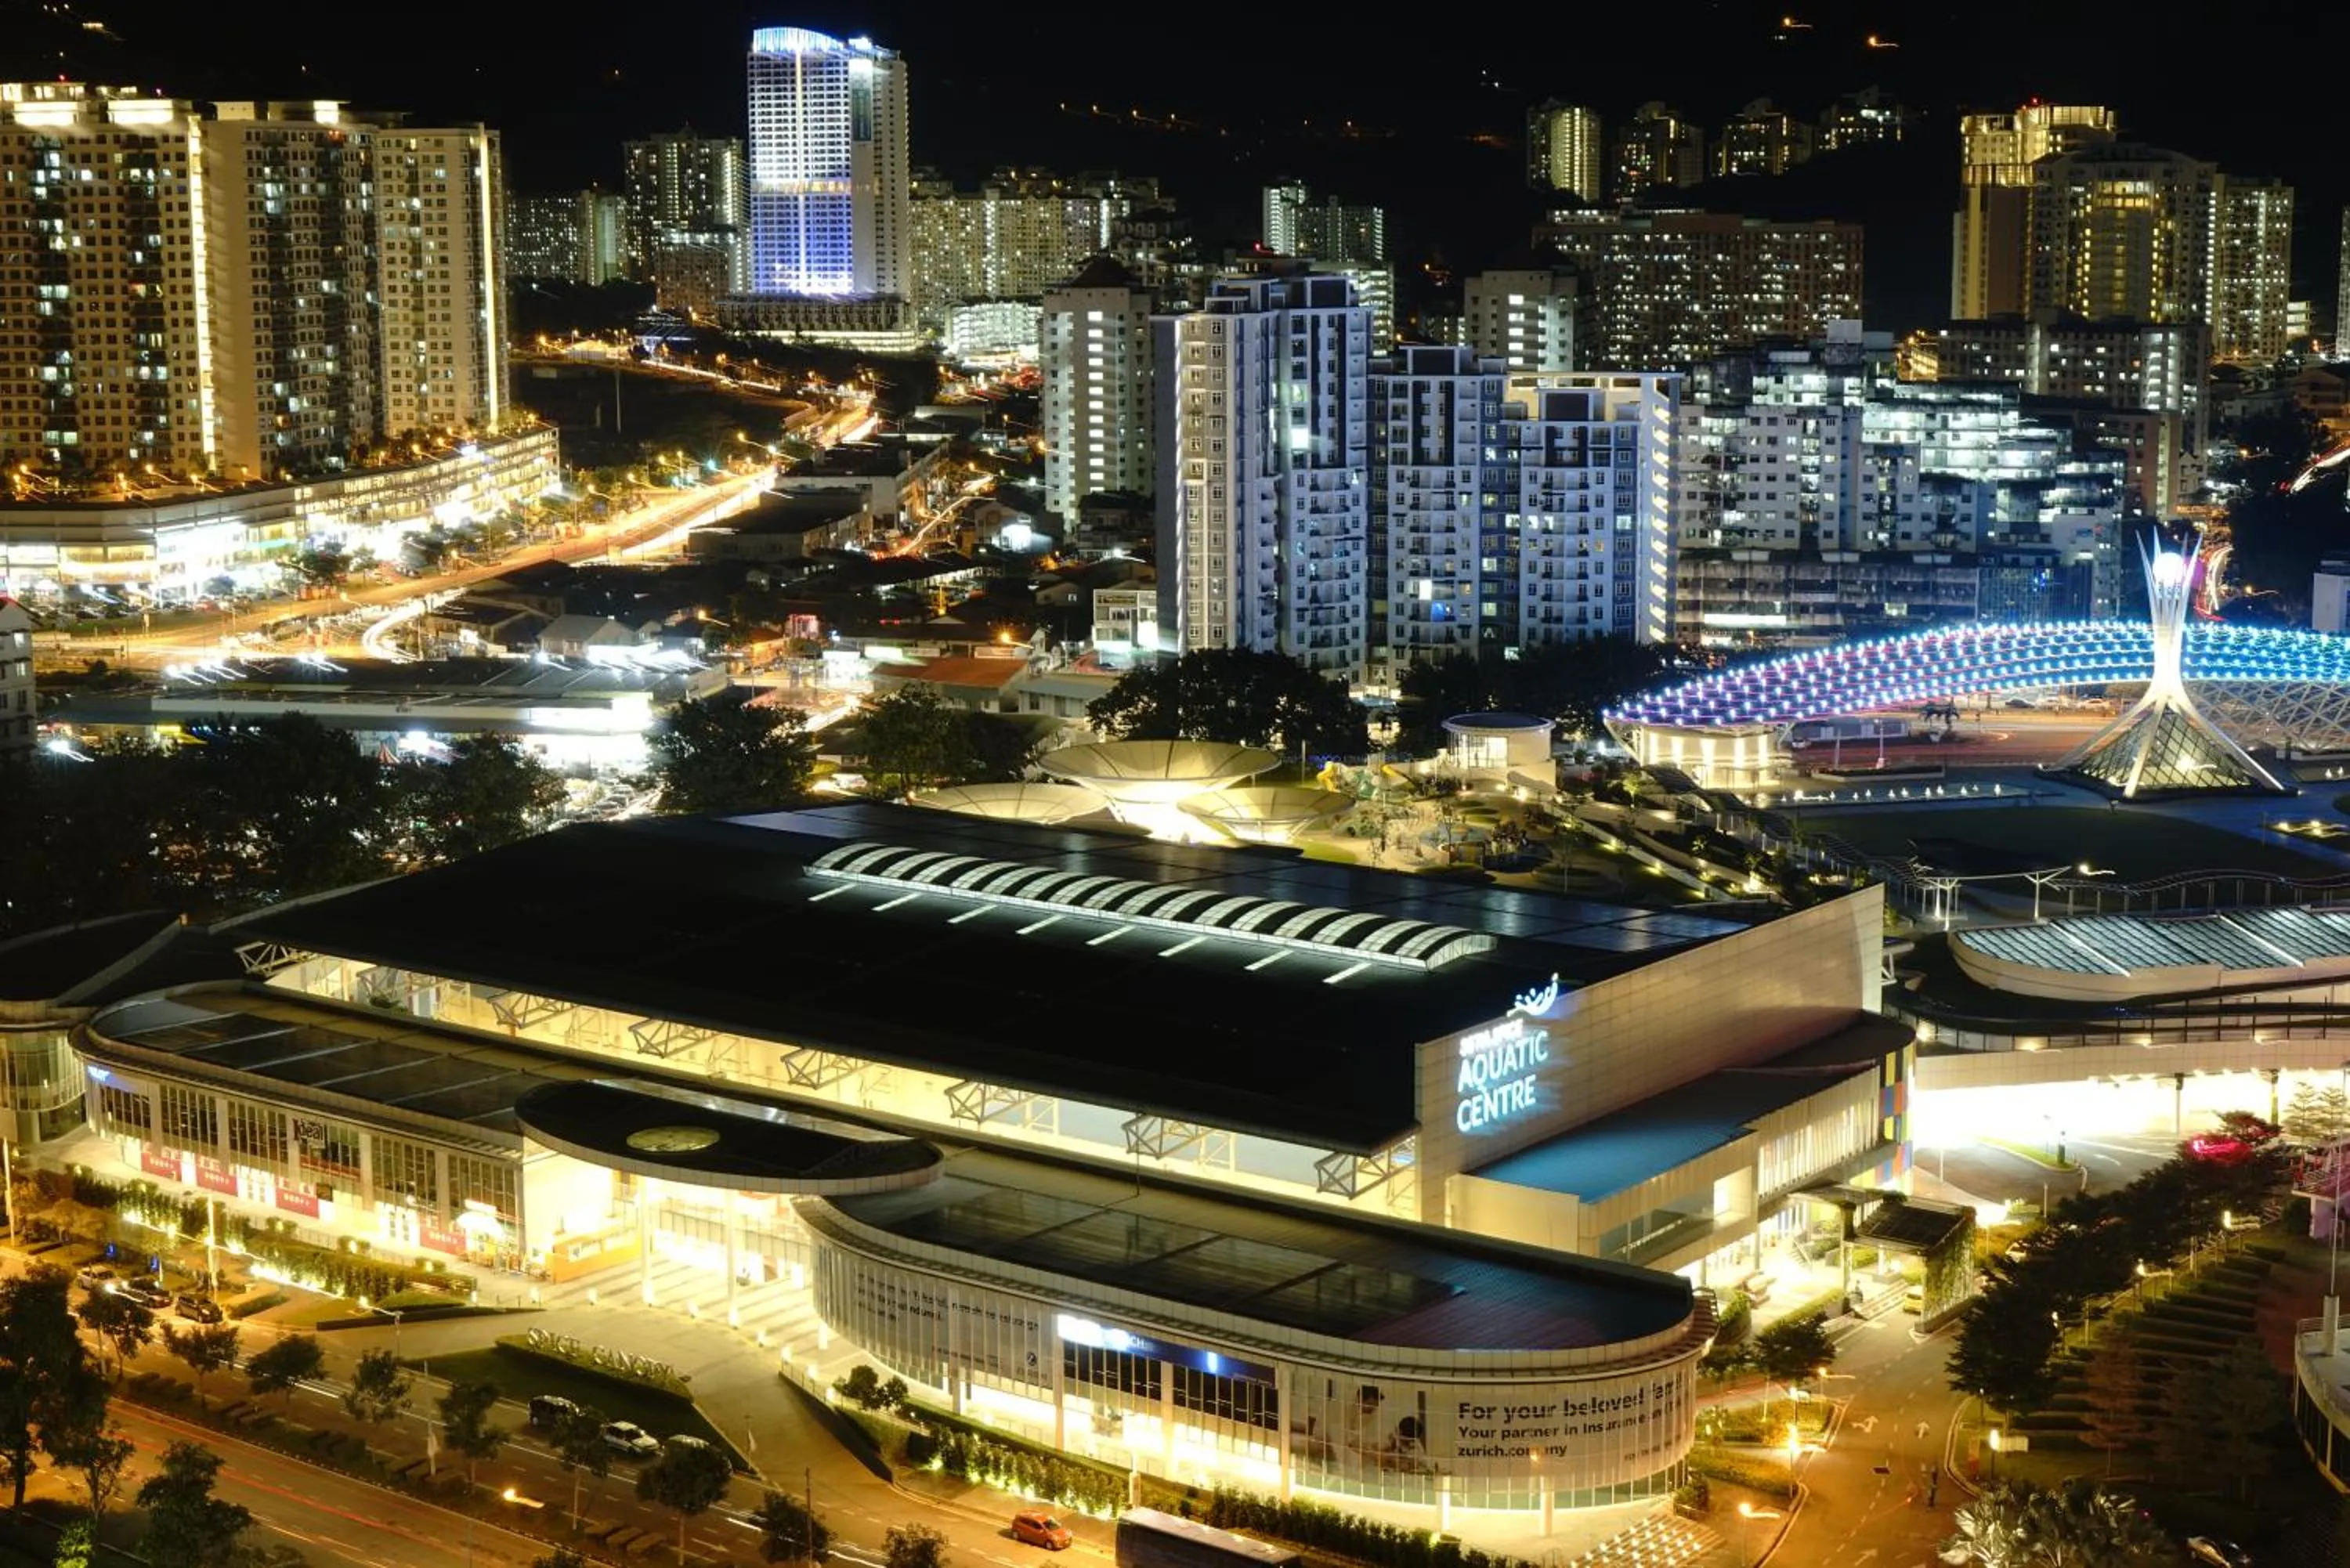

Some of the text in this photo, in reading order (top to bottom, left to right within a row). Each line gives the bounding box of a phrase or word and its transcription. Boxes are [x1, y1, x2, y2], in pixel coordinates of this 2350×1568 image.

[1458, 1031, 1548, 1093] AQUATIC
[1457, 1075, 1536, 1132] CENTRE
[1459, 1402, 1497, 1420] For
[1503, 1404, 1556, 1424] your
[1564, 1387, 1644, 1416] beloved
[1458, 1425, 1497, 1439] Your
[1501, 1425, 1560, 1440] partner
[1564, 1423, 1578, 1436] in
[1458, 1443, 1567, 1458] zurich.commy
